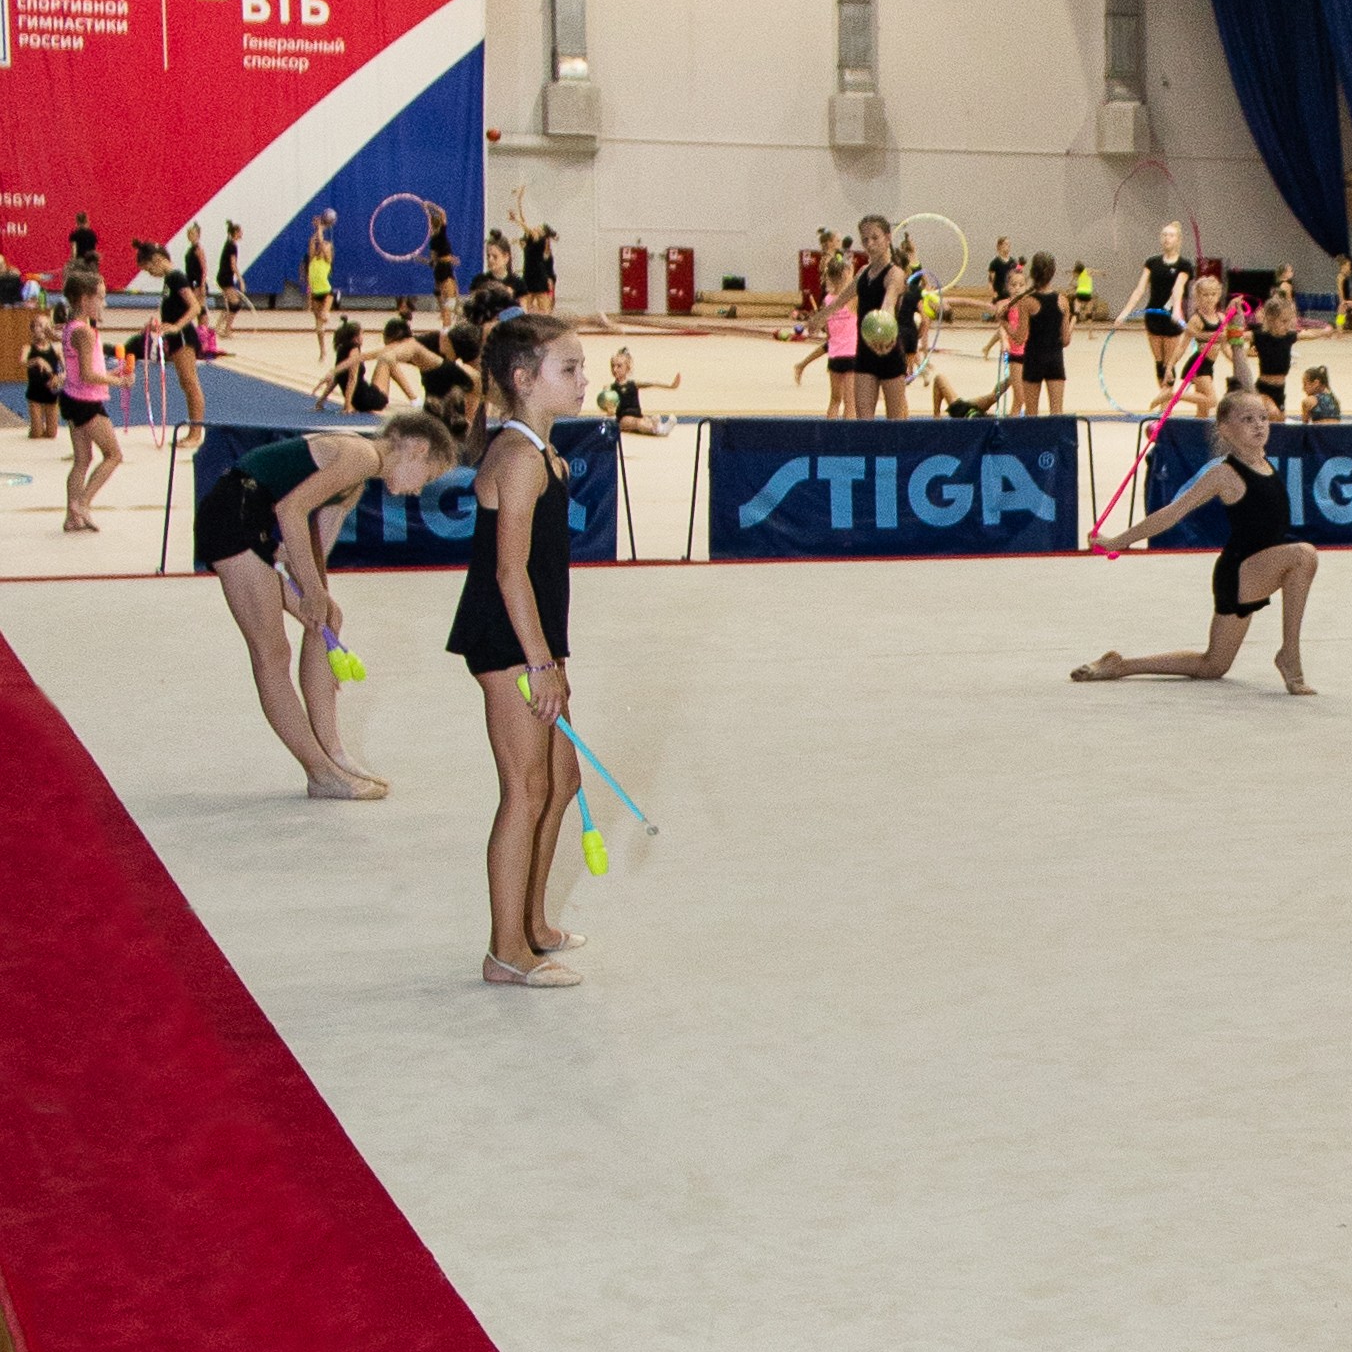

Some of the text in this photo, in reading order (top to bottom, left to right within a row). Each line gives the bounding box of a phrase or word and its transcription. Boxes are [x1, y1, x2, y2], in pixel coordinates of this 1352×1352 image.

[18, 14, 128, 34] ГИМНАСТИКИ
[18, 32, 84, 50] РОССИИ
[243, 33, 345, 54] Генеральный
[243, 54, 309, 73] спонсор
[738, 453, 1056, 529] STIGA
